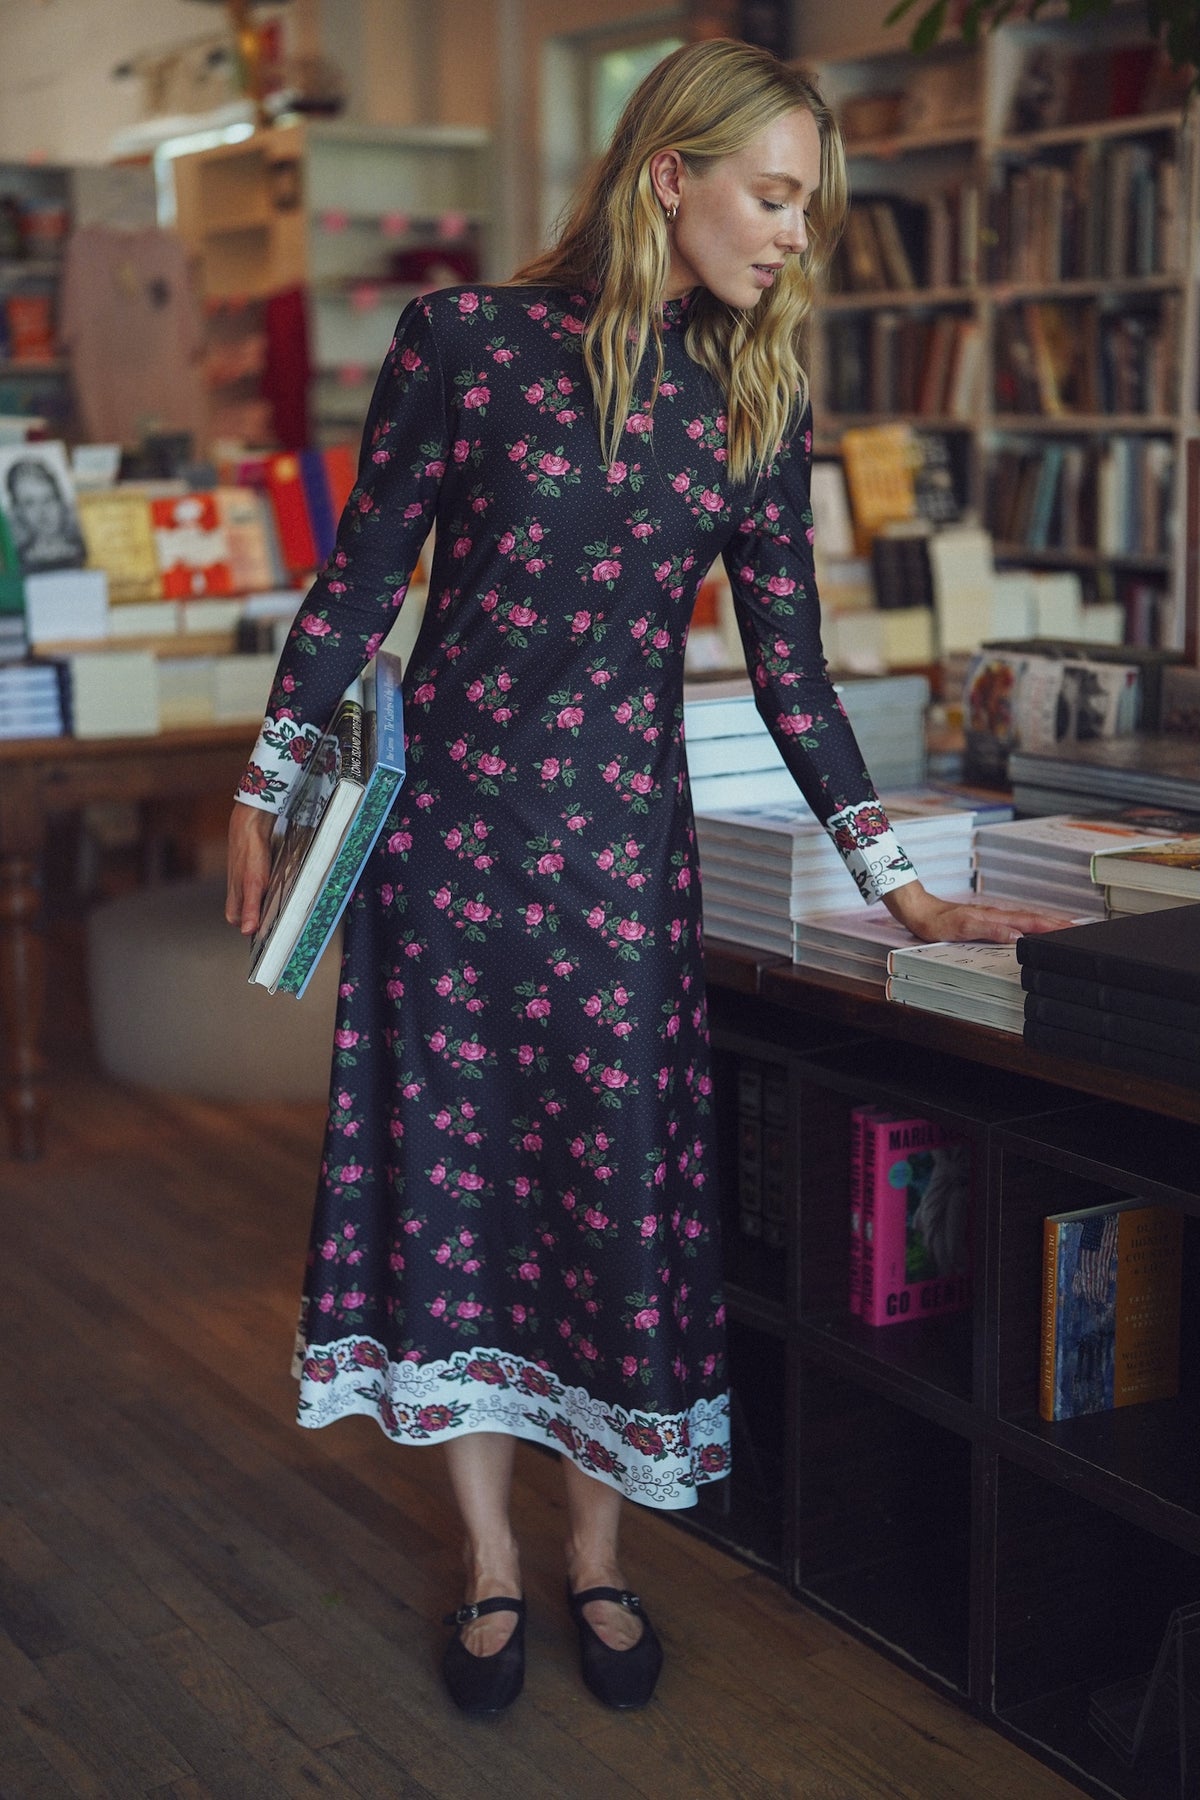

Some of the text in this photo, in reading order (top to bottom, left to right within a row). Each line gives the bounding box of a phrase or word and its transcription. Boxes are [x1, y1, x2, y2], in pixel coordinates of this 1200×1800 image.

[352, 736, 361, 759] ISLAND
[351, 757, 361, 777] LONG
[889, 1125, 935, 1151] MARIA
[886, 1290, 911, 1316] GO
